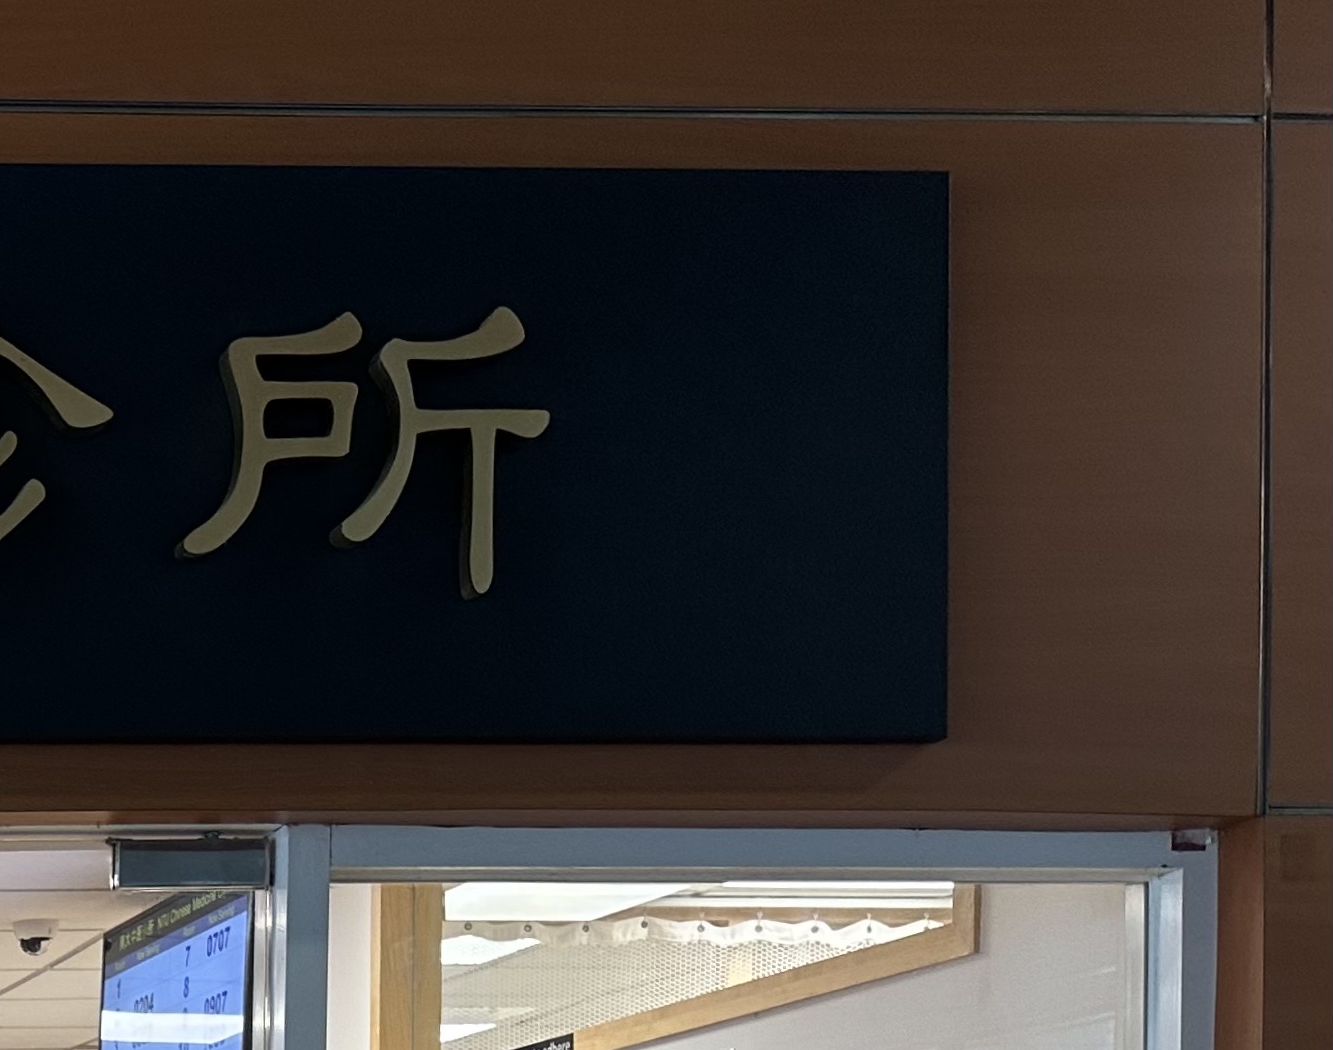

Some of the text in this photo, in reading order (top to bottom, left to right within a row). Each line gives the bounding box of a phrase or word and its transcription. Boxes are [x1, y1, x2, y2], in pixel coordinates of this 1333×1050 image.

[207, 926, 230, 956] 0707
[186, 945, 191, 967] 7
[117, 979, 121, 998] 1
[184, 977, 189, 997] 8
